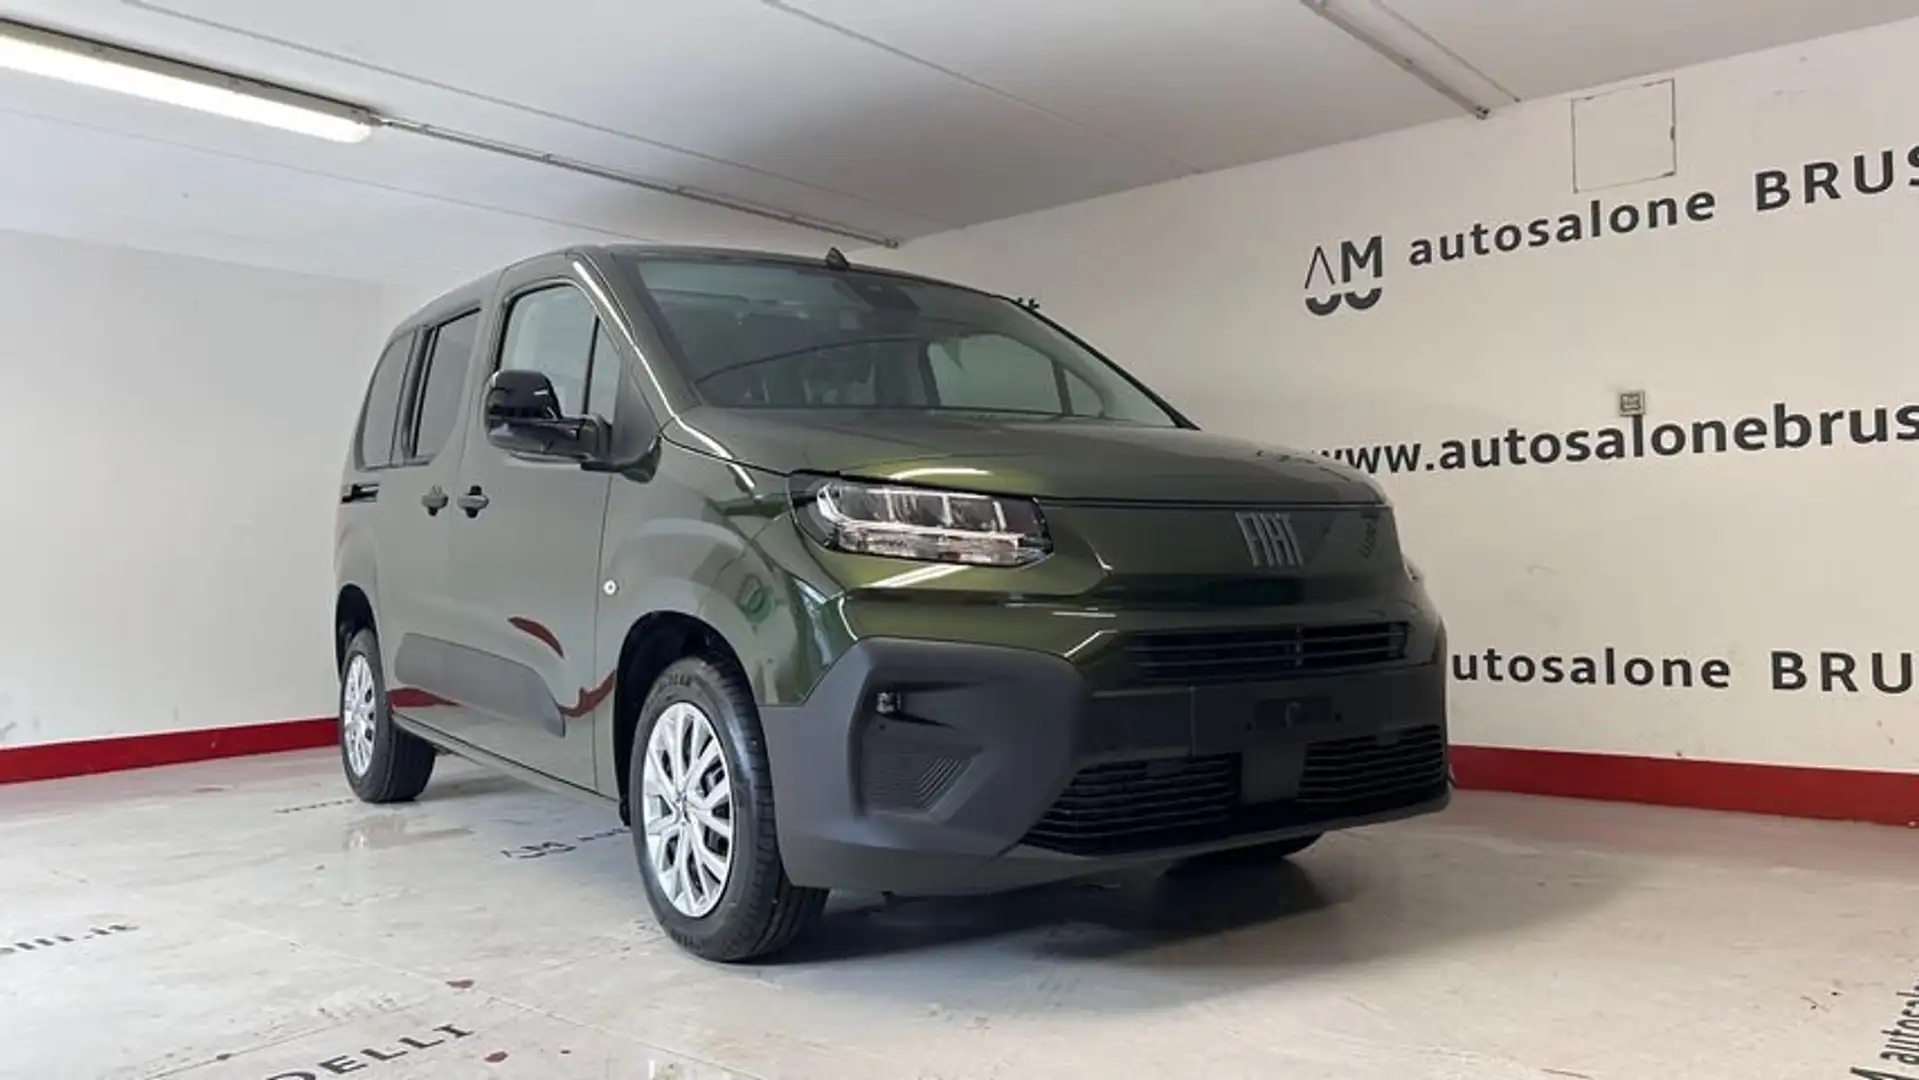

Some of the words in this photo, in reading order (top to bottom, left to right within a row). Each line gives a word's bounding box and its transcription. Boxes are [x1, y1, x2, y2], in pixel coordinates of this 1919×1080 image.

[1408, 190, 1717, 266] autosalone
[1234, 511, 1304, 568] FIAT
[1452, 647, 1730, 689] utosalone
[1770, 650, 1913, 694] BRU
